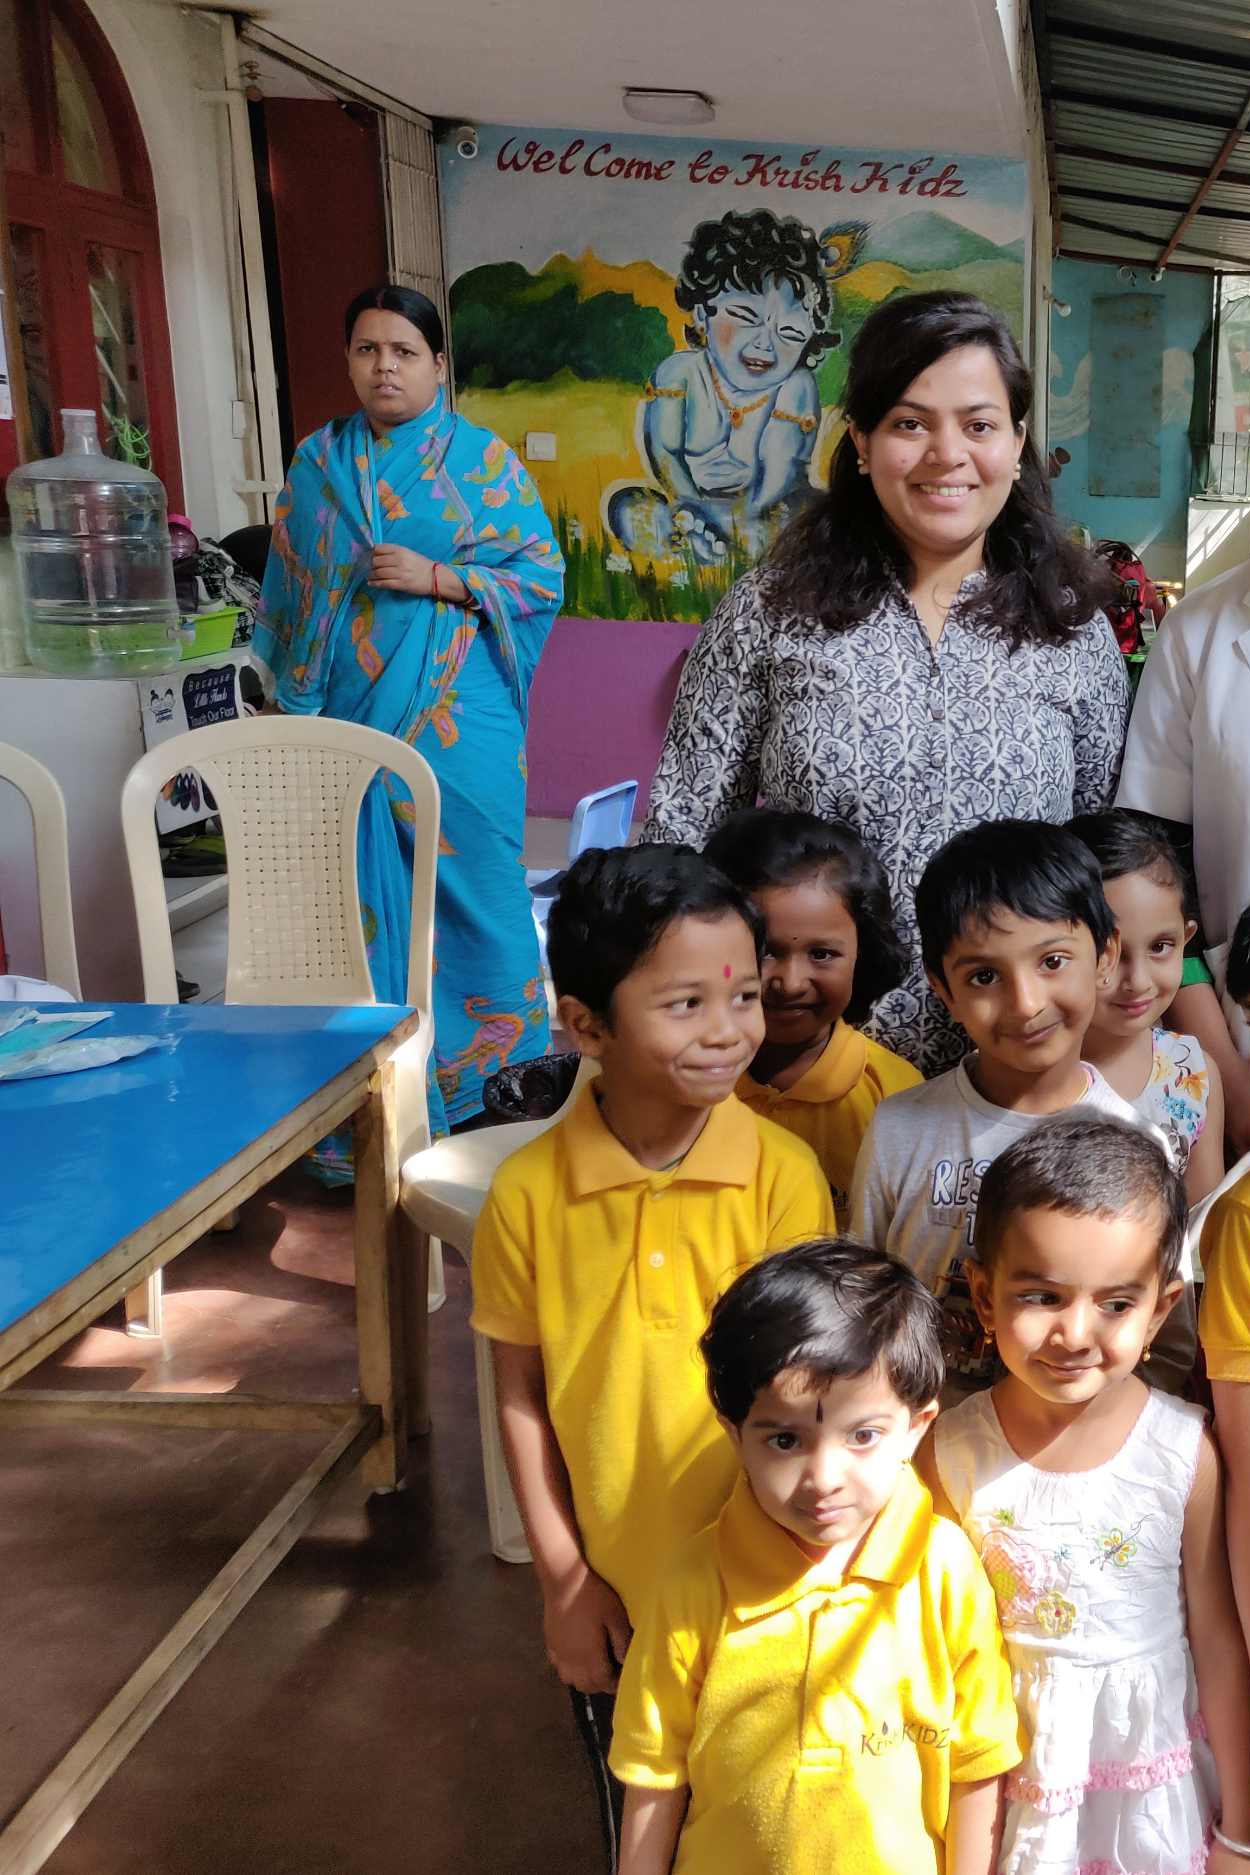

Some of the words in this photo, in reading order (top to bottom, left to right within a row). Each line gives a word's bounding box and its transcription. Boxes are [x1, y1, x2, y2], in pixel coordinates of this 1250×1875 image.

[688, 149, 732, 184] to
[734, 147, 844, 195] Krish
[850, 155, 968, 200] Kidz
